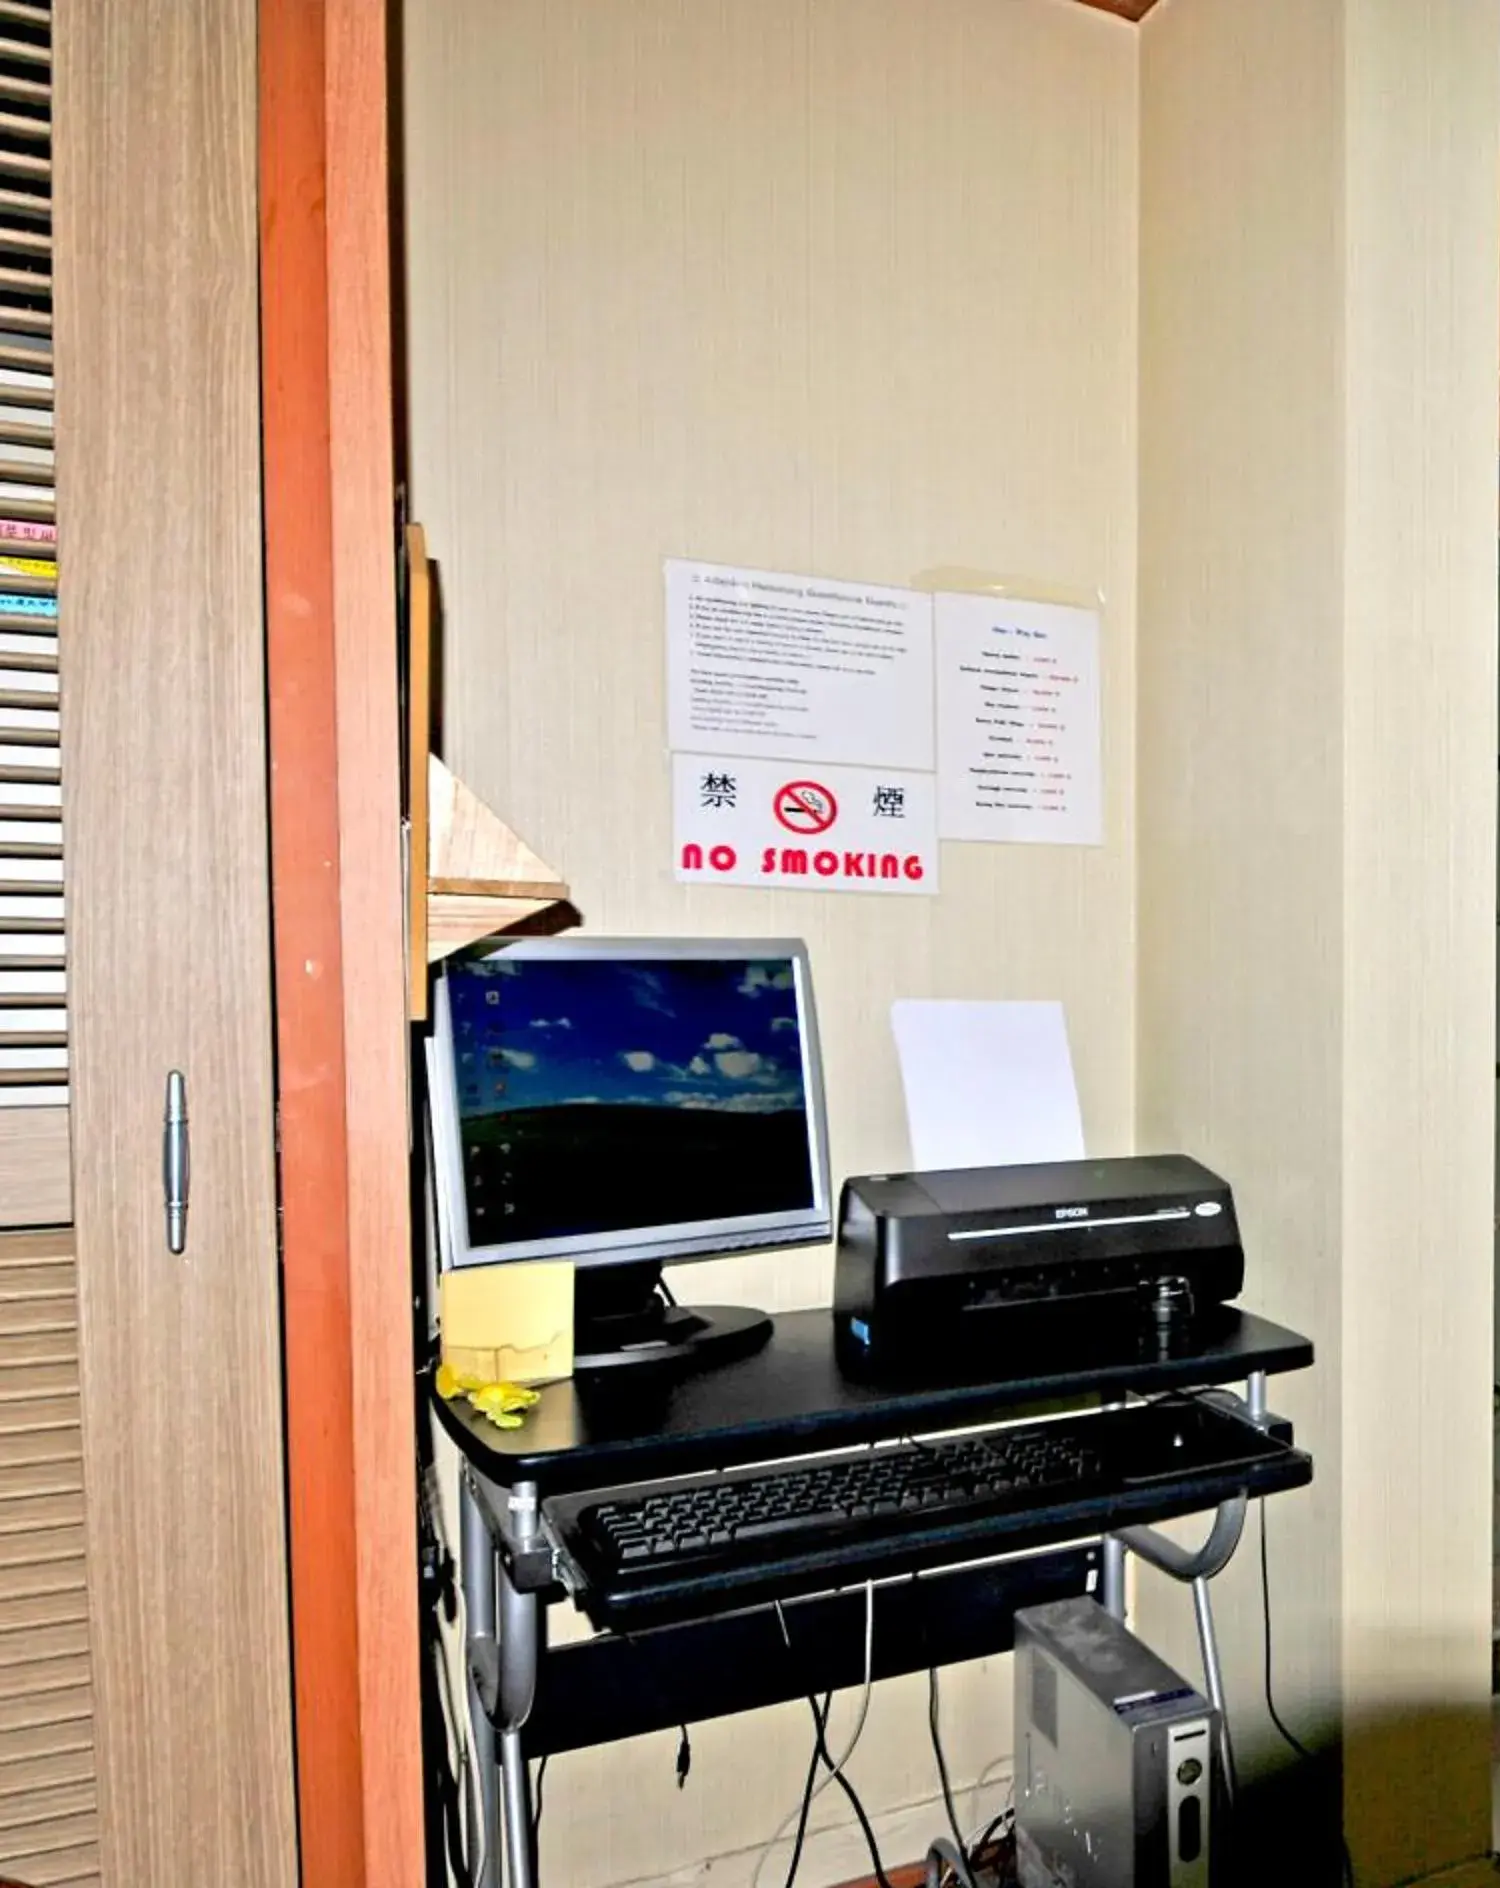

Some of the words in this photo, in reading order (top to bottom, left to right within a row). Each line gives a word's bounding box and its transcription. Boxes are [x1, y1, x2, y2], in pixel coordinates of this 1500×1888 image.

[700, 772, 737, 808] 禁
[872, 785, 905, 819] 煙
[682, 843, 736, 871] NO
[761, 847, 923, 880] SMOKING
[1055, 1207, 1089, 1219] EPSON
